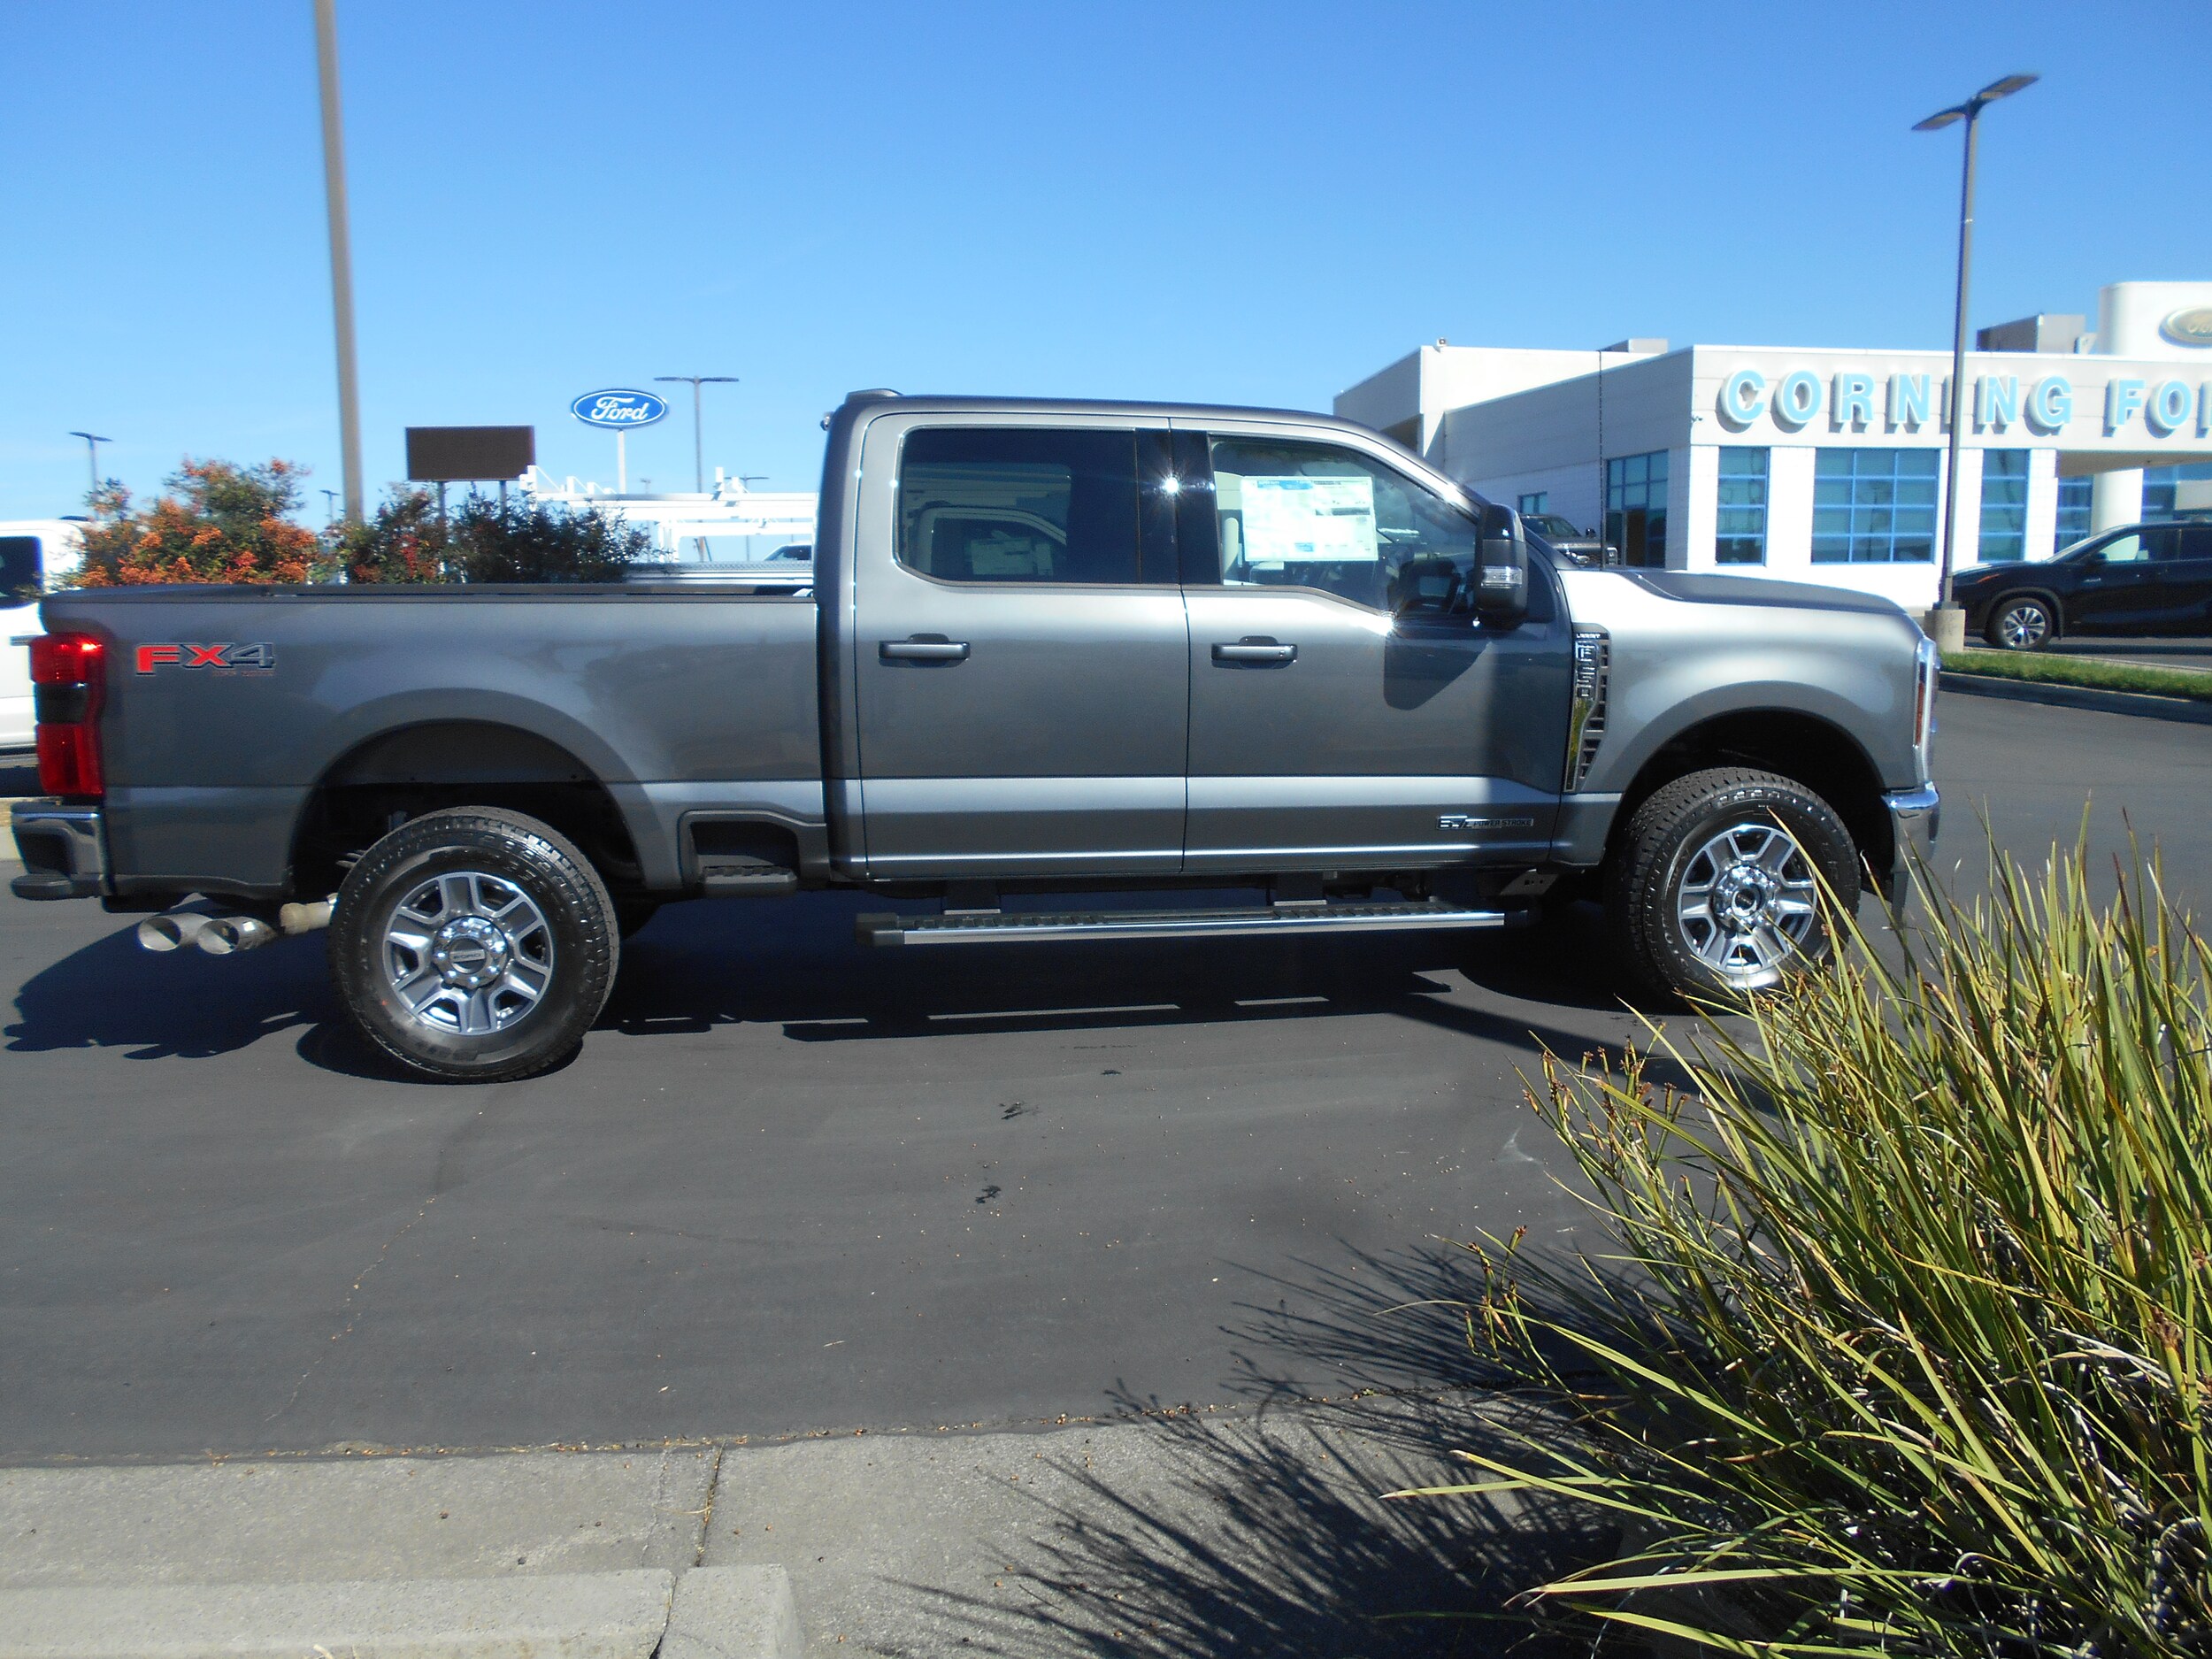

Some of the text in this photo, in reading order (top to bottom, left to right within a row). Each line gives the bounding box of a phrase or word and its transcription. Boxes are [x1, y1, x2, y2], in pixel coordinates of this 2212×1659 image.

[591, 396, 649, 420] Ford
[1719, 368, 2212, 429] CORNNG FO
[135, 642, 275, 676] FX4
